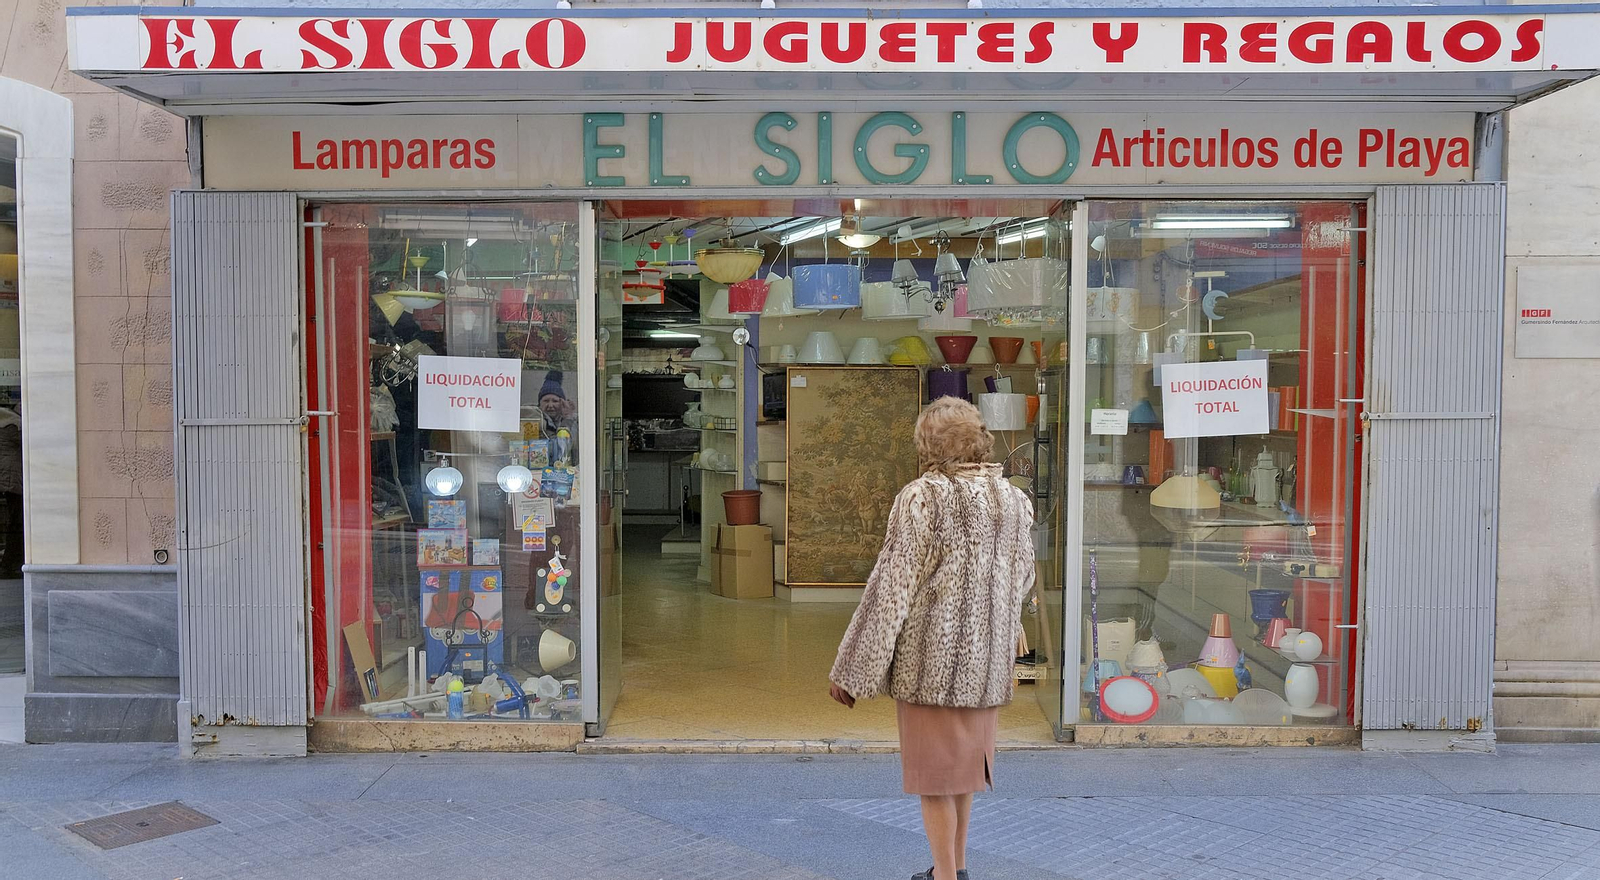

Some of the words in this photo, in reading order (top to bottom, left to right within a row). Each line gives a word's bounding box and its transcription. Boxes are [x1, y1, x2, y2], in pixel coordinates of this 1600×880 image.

[142, 19, 263, 69] EL
[299, 19, 586, 69] SIGLO
[667, 22, 1055, 63] JUGUETES
[1093, 23, 1139, 63] Y
[1183, 19, 1544, 63] REGALOS
[293, 131, 496, 178] Lamparas
[584, 112, 692, 187] EL
[754, 111, 1081, 186] SIGLO
[1092, 128, 1279, 169] Articulos
[1294, 129, 1343, 169] de
[1359, 129, 1470, 176] Playa
[426, 372, 516, 388] LIQUIDACIÓN
[1170, 374, 1262, 394] LIQUIDACIÓN
[448, 396, 492, 409] TOTAL
[1194, 401, 1240, 414] TOTAL
